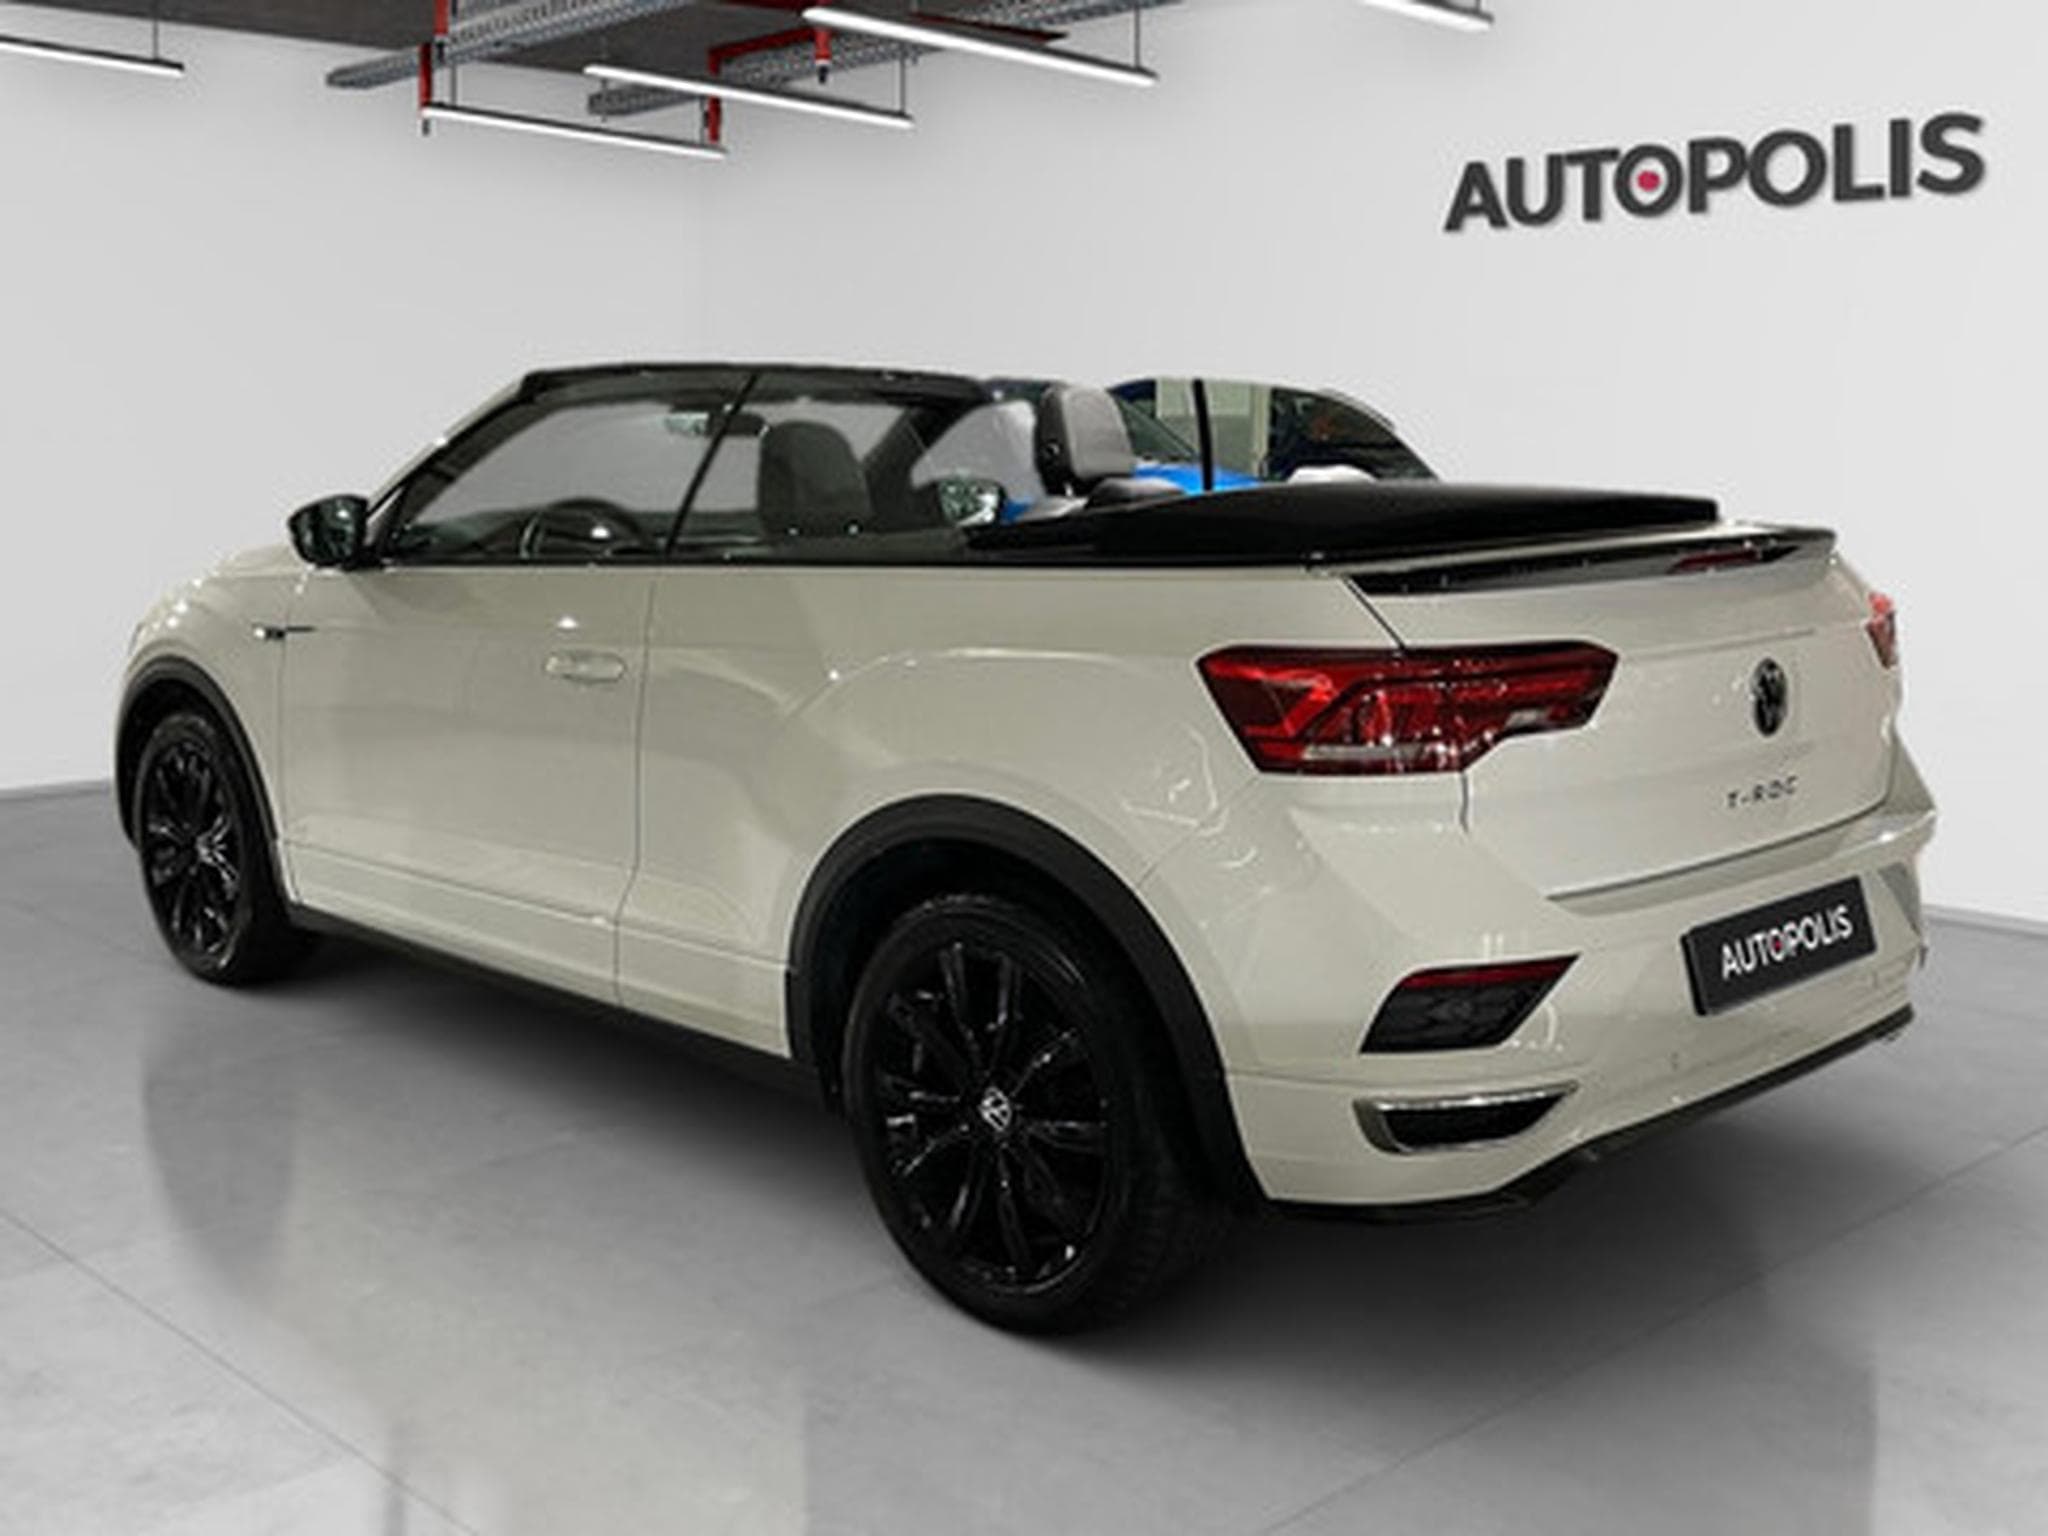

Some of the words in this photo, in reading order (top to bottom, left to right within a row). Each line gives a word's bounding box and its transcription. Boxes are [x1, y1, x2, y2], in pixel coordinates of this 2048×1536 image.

[1444, 113, 1985, 232] AUTOPOLIS
[1727, 775, 1798, 808] T-ROC
[1721, 904, 1854, 980] AUTOPOLIS
